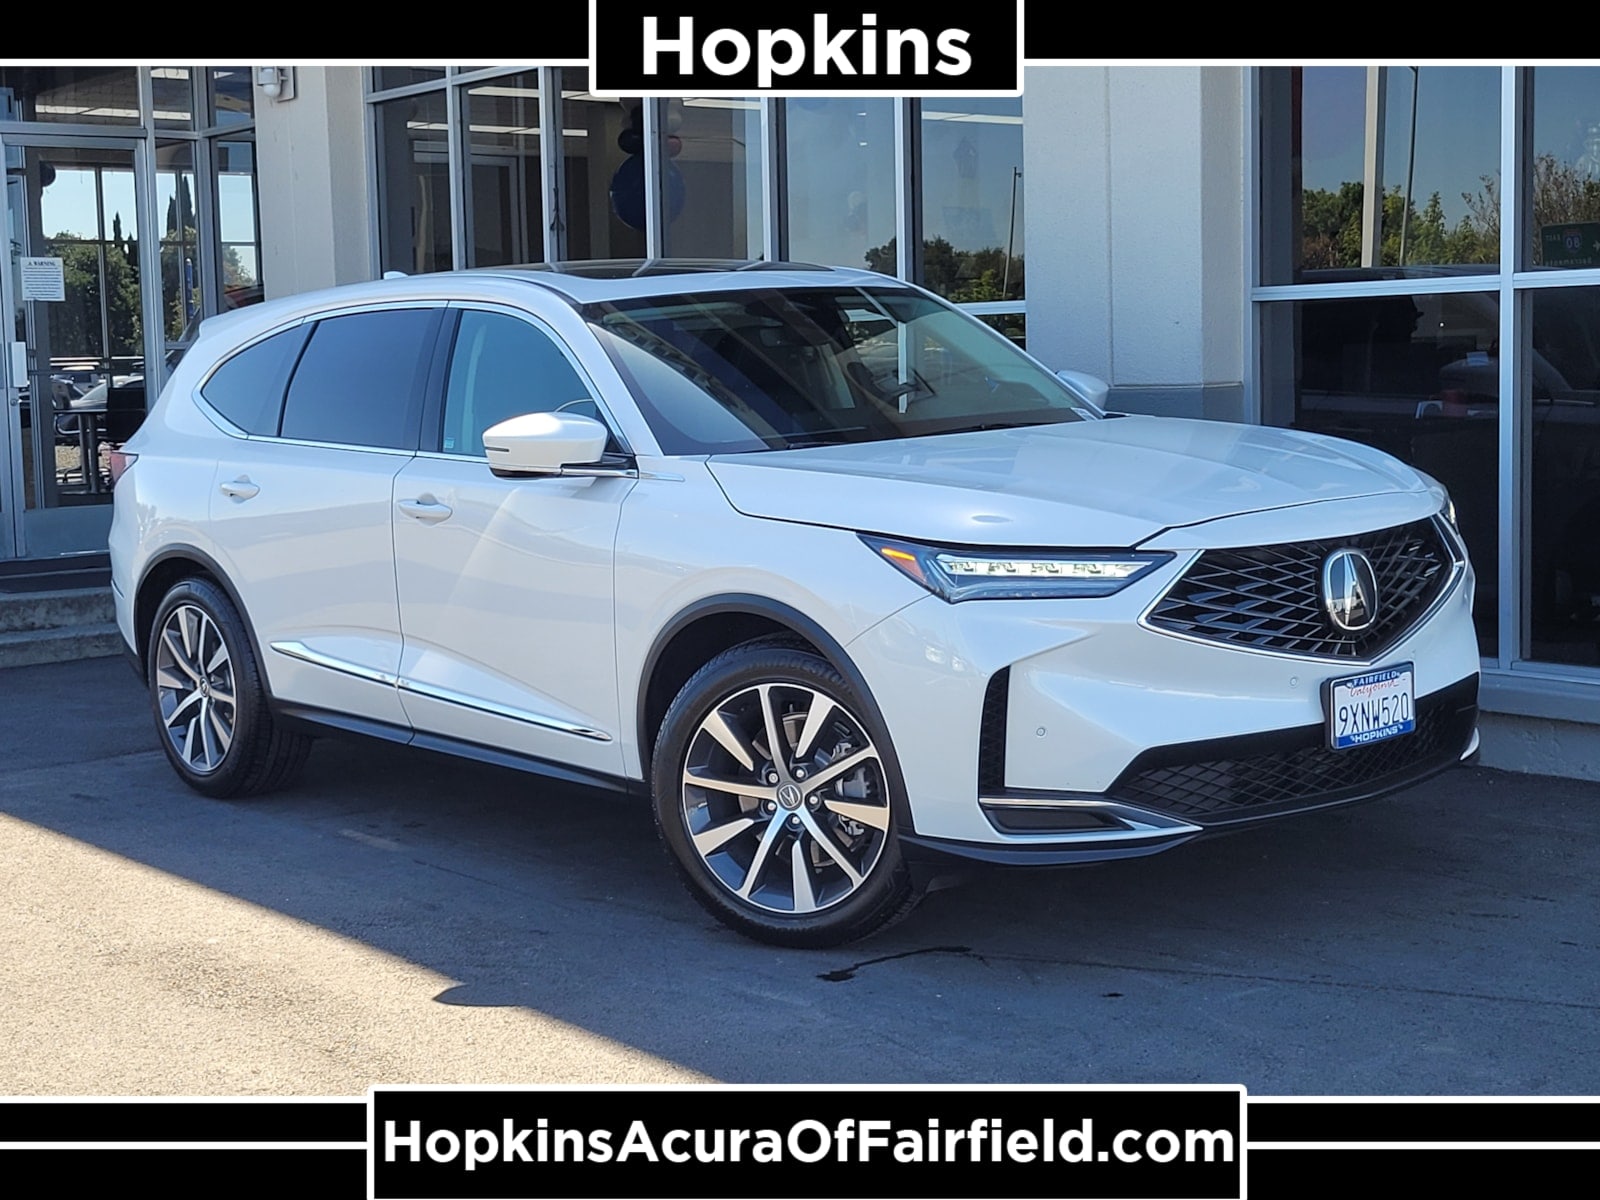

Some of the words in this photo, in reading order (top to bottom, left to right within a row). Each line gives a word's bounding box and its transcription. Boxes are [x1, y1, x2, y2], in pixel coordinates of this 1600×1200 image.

[1353, 670, 1397, 687] FAIRFIELD
[1339, 692, 1409, 736] 9XNW520
[1354, 725, 1398, 743] HOPKINS
